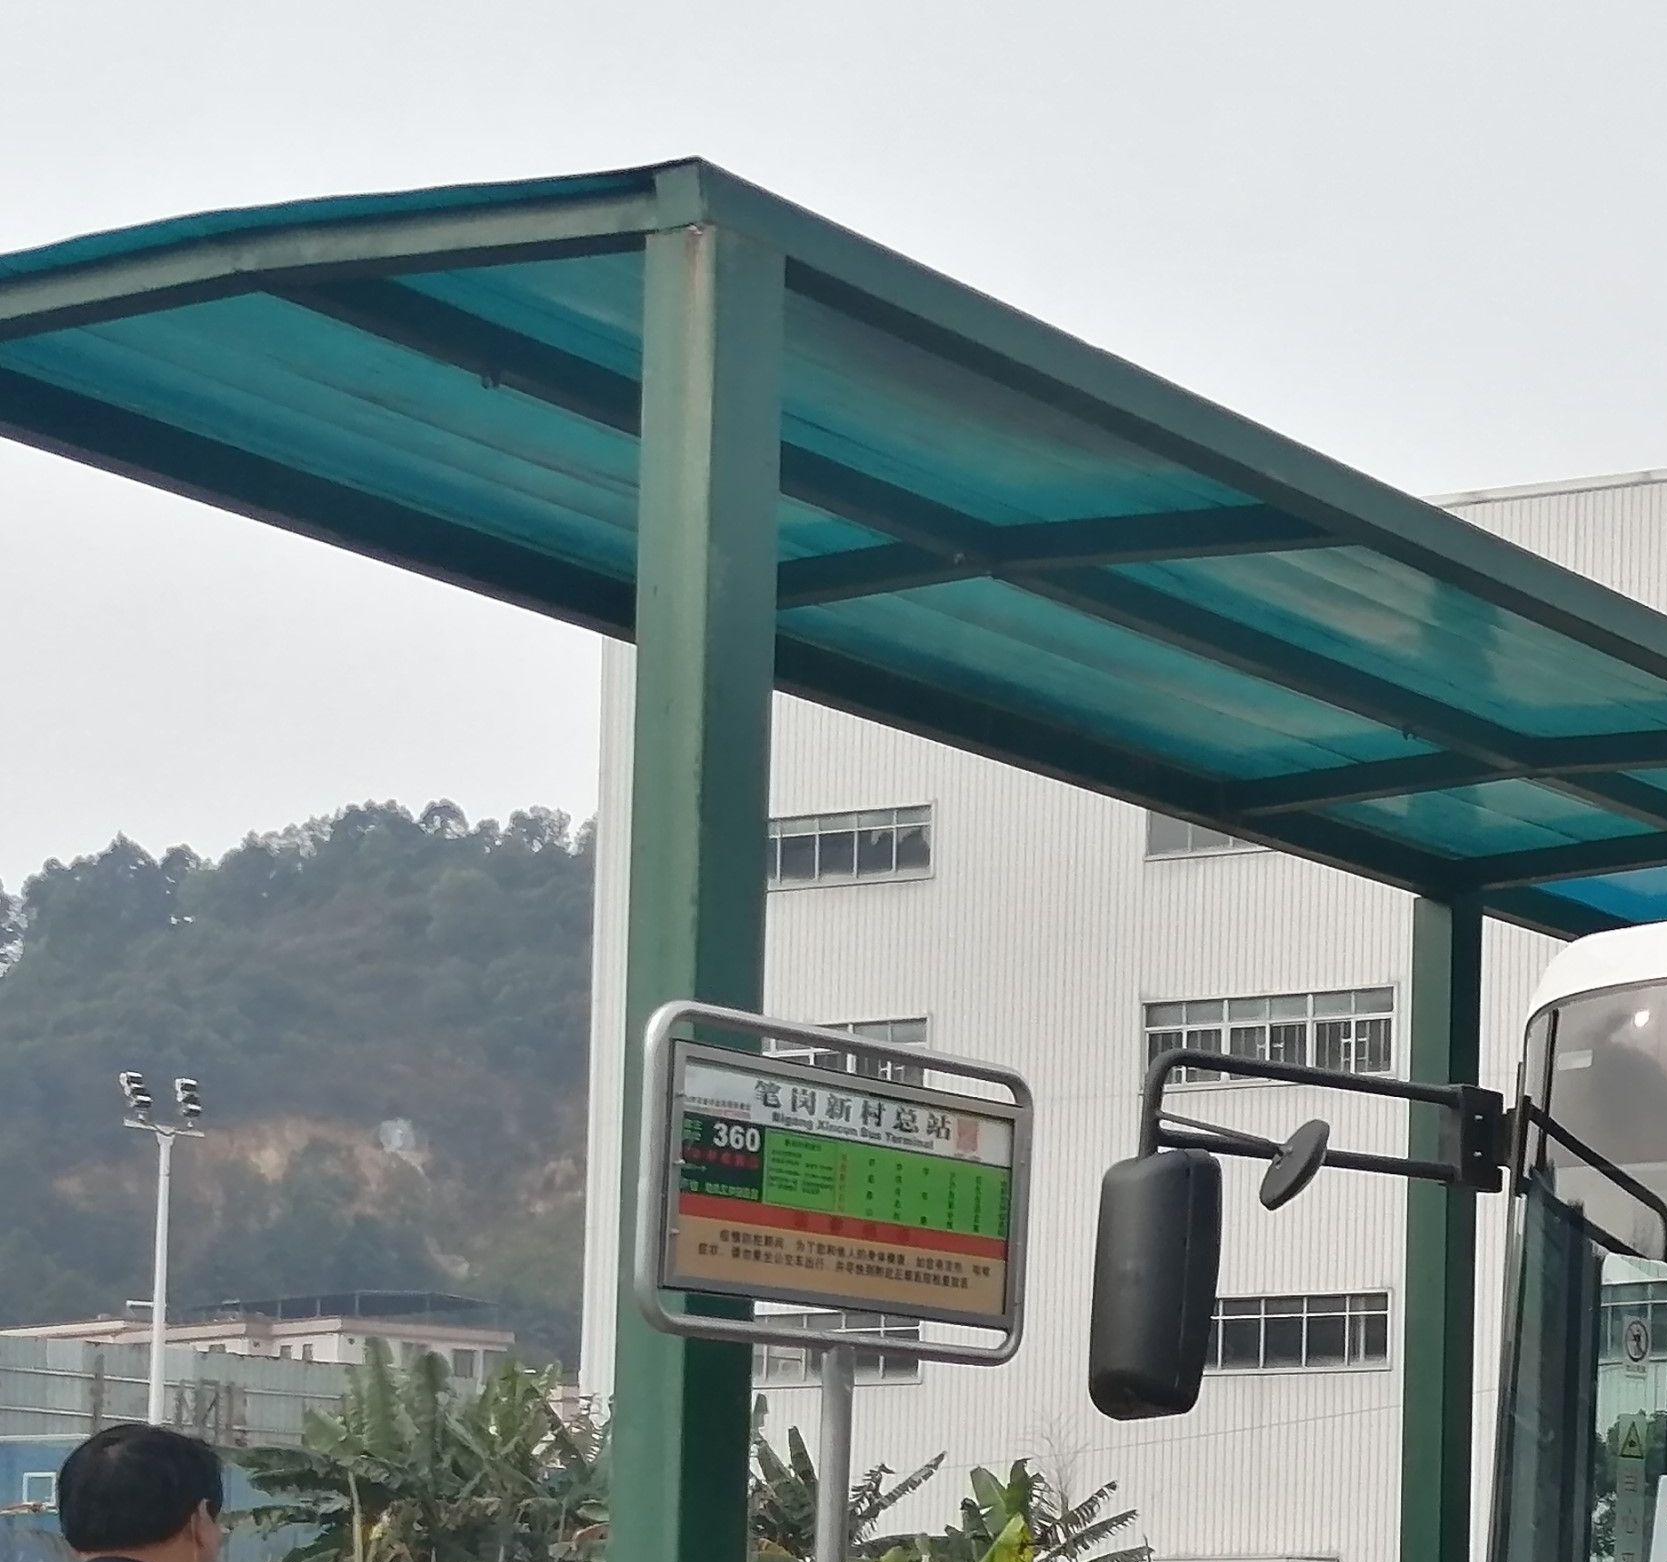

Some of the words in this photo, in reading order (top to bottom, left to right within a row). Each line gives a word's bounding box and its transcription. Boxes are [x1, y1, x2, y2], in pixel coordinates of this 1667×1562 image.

[754, 1080, 951, 1141] 笔岗新村总站
[712, 1122, 761, 1153] 360
[861, 1126, 881, 1140] Bus
